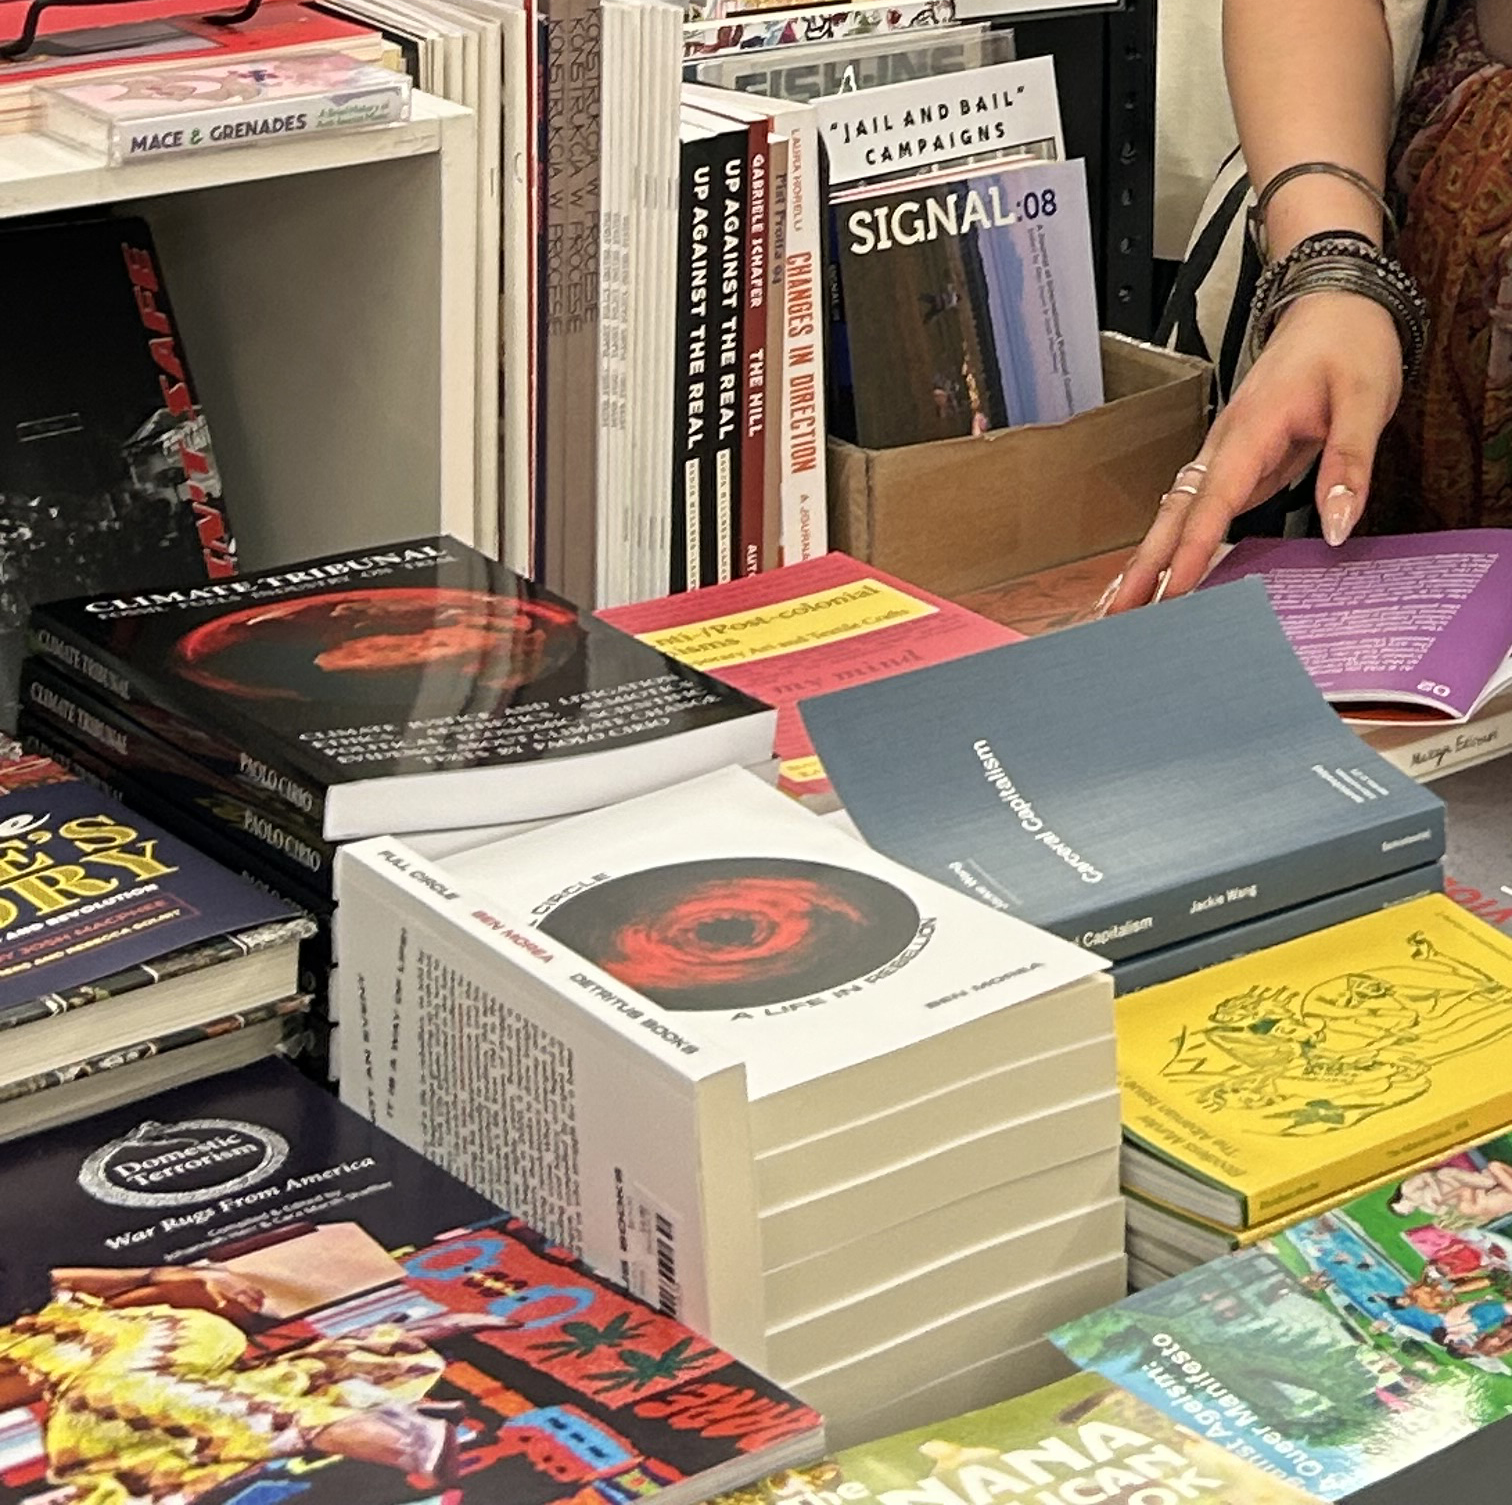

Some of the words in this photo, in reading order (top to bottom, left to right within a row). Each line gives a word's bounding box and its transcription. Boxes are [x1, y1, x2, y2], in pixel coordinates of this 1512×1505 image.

[130, 130, 185, 153] MACE
[189, 127, 203, 145] &
[209, 113, 307, 143] GRENADES
[902, 103, 950, 128] AND
[790, 128, 803, 180] LAURA
[865, 121, 1006, 166] CAMPAIGNS
[691, 166, 711, 201] UP
[724, 159, 742, 193] UP
[750, 153, 766, 234] GABRIELE
[689, 207, 709, 318] AGAINST
[721, 198, 741, 309] AGAINST
[787, 251, 815, 339] CHANGES
[688, 324, 707, 376] THE
[719, 316, 738, 368] THE
[748, 348, 765, 388] THE
[788, 344, 815, 367] IN
[686, 382, 705, 451] REAL
[718, 372, 736, 441] REAL
[748, 390, 765, 438] HILL
[790, 372, 817, 474] DIRECTION
[800, 506, 812, 561] JOURNA
[84, 581, 257, 614] CLIMATE
[257, 545, 450, 588] TRIBUNAL
[39, 630, 82, 668] CLIMATE
[240, 752, 279, 790] PAOLO
[278, 776, 313, 812] CIRIO
[30, 681, 77, 724] CLIMATE
[243, 811, 285, 851] PAOLO
[283, 836, 322, 873] CIRIO
[973, 739, 1044, 833] Capitalism
[1034, 831, 1104, 884] Carceral
[6, 923, 45, 941] AND
[45, 883, 160, 927] REVOLUTION
[531, 871, 611, 917] CIRCLE
[1189, 891, 1226, 915] Jackie
[1225, 883, 1259, 906] Wang
[378, 850, 411, 872] FULL
[409, 870, 461, 901] CIRCLE
[470, 909, 505, 931] BEN
[501, 928, 556, 964] MOREA
[568, 972, 645, 1021] DETRITUS
[641, 1017, 701, 1056] BOOKS
[730, 1009, 756, 1023] A
[764, 997, 825, 1019] LIFE
[832, 982, 863, 1003] IN
[113, 1133, 242, 1179] Domestic
[126, 1143, 259, 1187] Terrorism
[104, 1226, 157, 1251] War
[159, 1206, 217, 1233] Rugs
[219, 1186, 281, 1214] From
[285, 1156, 377, 1192] America
[1141, 1359, 1234, 1439] Ageism:
[1151, 1332, 1259, 1427] Manifesto
[1250, 1424, 1324, 1477] Queer
